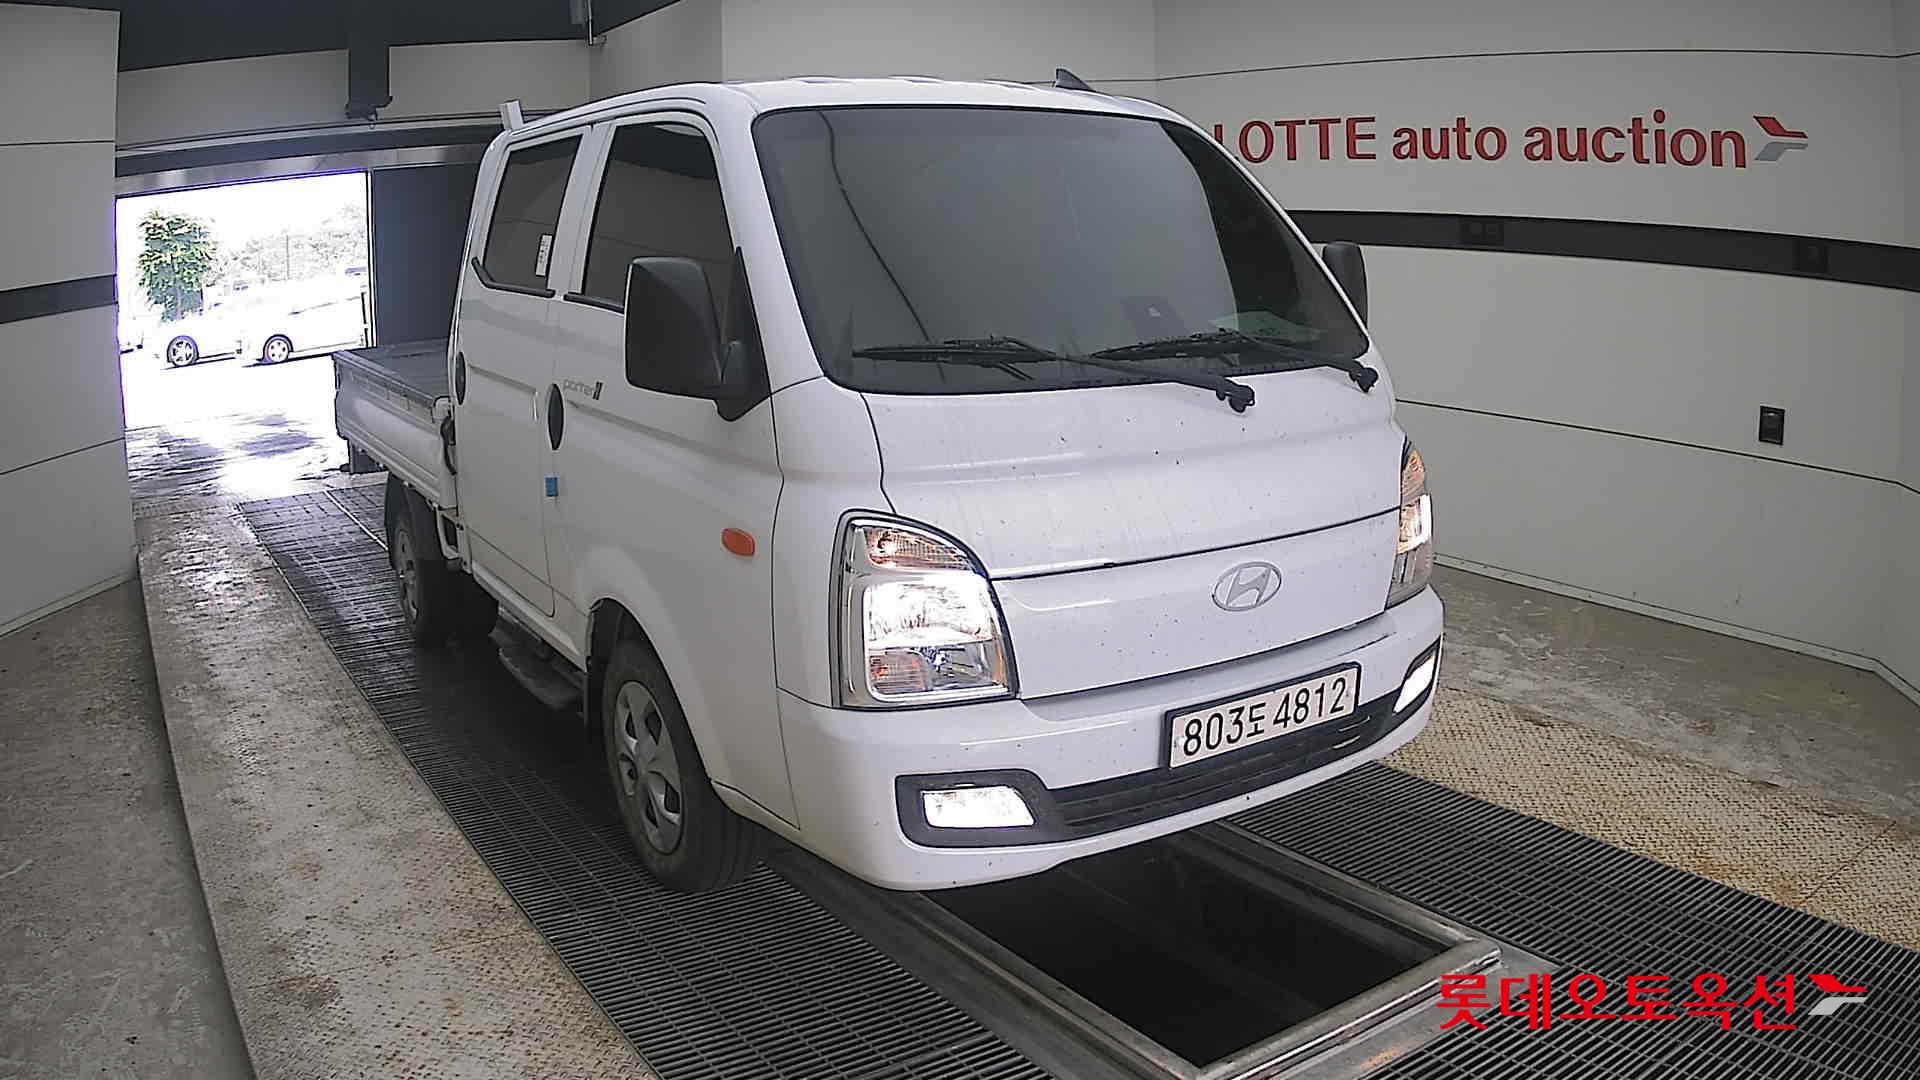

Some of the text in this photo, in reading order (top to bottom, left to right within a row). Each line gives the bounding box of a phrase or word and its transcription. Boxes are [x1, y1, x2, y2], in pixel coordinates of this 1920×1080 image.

[1392, 118, 1507, 162] auto
[1524, 110, 1747, 168] auction
[1183, 677, 1346, 757] 803도 4812
